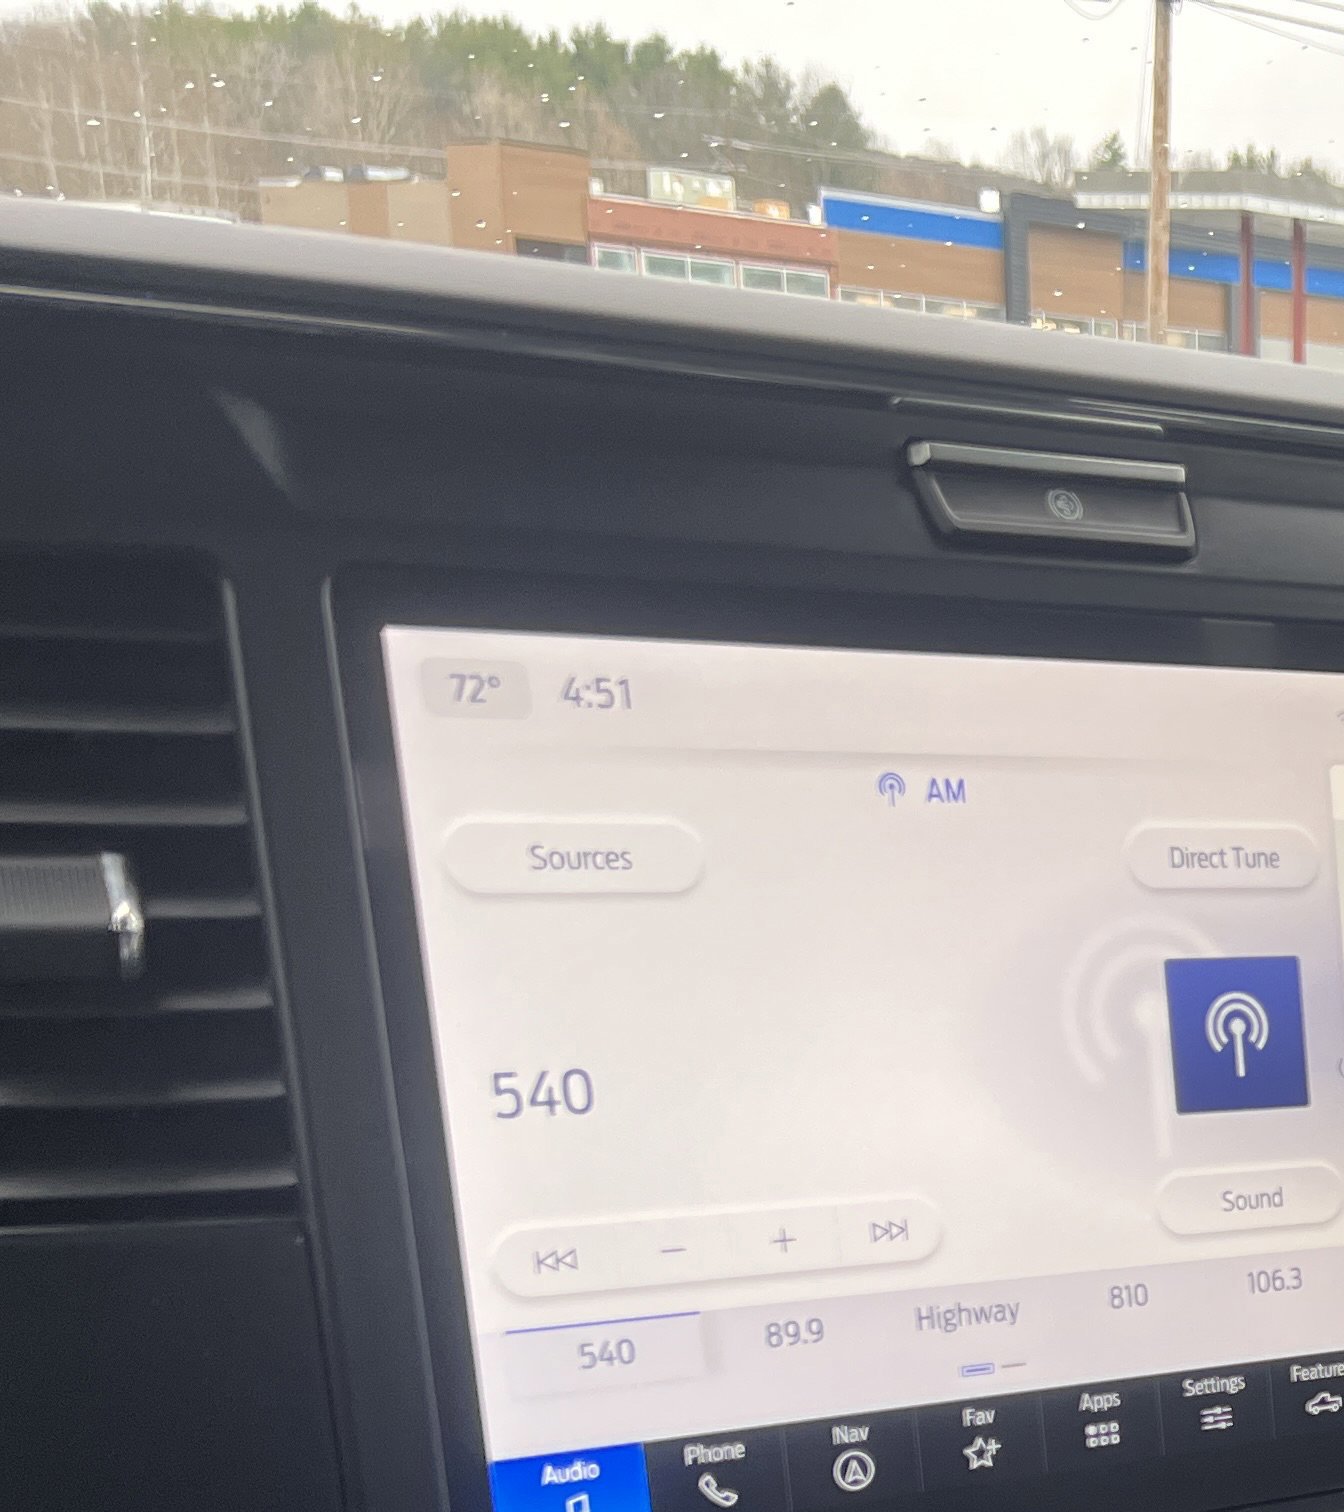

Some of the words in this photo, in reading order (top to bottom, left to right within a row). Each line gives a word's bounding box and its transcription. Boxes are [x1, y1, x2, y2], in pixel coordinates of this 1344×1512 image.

[560, 676, 634, 711] 4:51
[926, 778, 968, 805] AM
[528, 844, 634, 872] Sources
[1169, 845, 1228, 870] Direct
[1231, 846, 1281, 870] Tune
[490, 1066, 596, 1120] 540
[1221, 1186, 1285, 1212] Sound
[1246, 1266, 1304, 1295] 106.3
[1109, 1283, 1150, 1310] 810
[915, 1300, 1021, 1334] Highway
[764, 1317, 825, 1349] 89.9
[577, 1337, 637, 1370] 540
[1181, 1372, 1247, 1398] Settings
[1078, 1391, 1122, 1413] Apps
[961, 1407, 998, 1428] Fav
[831, 1423, 870, 1445] Nav
[683, 1439, 747, 1466] Phone
[541, 1458, 602, 1486] Audio
